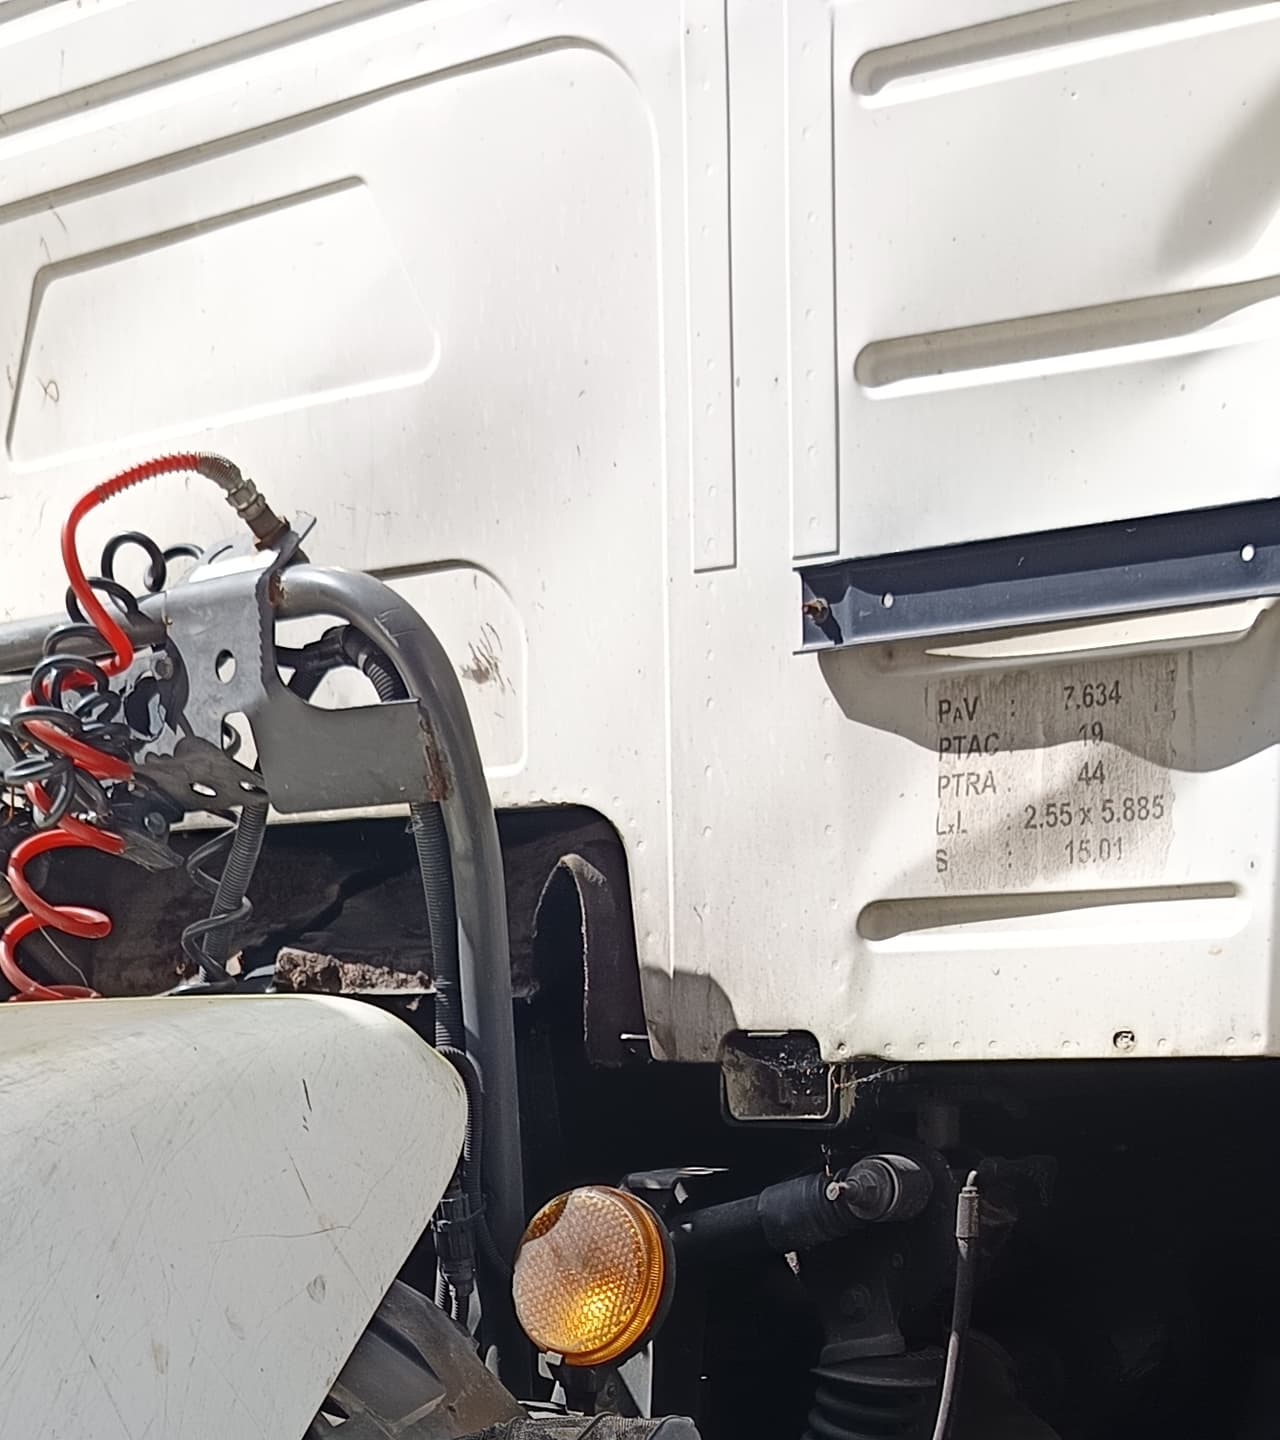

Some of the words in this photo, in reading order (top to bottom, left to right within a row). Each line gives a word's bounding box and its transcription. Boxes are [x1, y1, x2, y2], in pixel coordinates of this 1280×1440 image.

[1063, 679, 1122, 711] 7.634
[938, 732, 1000, 762] PTAC
[1078, 721, 1104, 747] 19
[937, 770, 997, 799] PTRA
[1078, 760, 1106, 787] 44
[1023, 803, 1073, 830] 2.55
[1101, 795, 1164, 824] 5.885
[935, 849, 949, 873] S
[1064, 837, 1123, 865] 15.01
